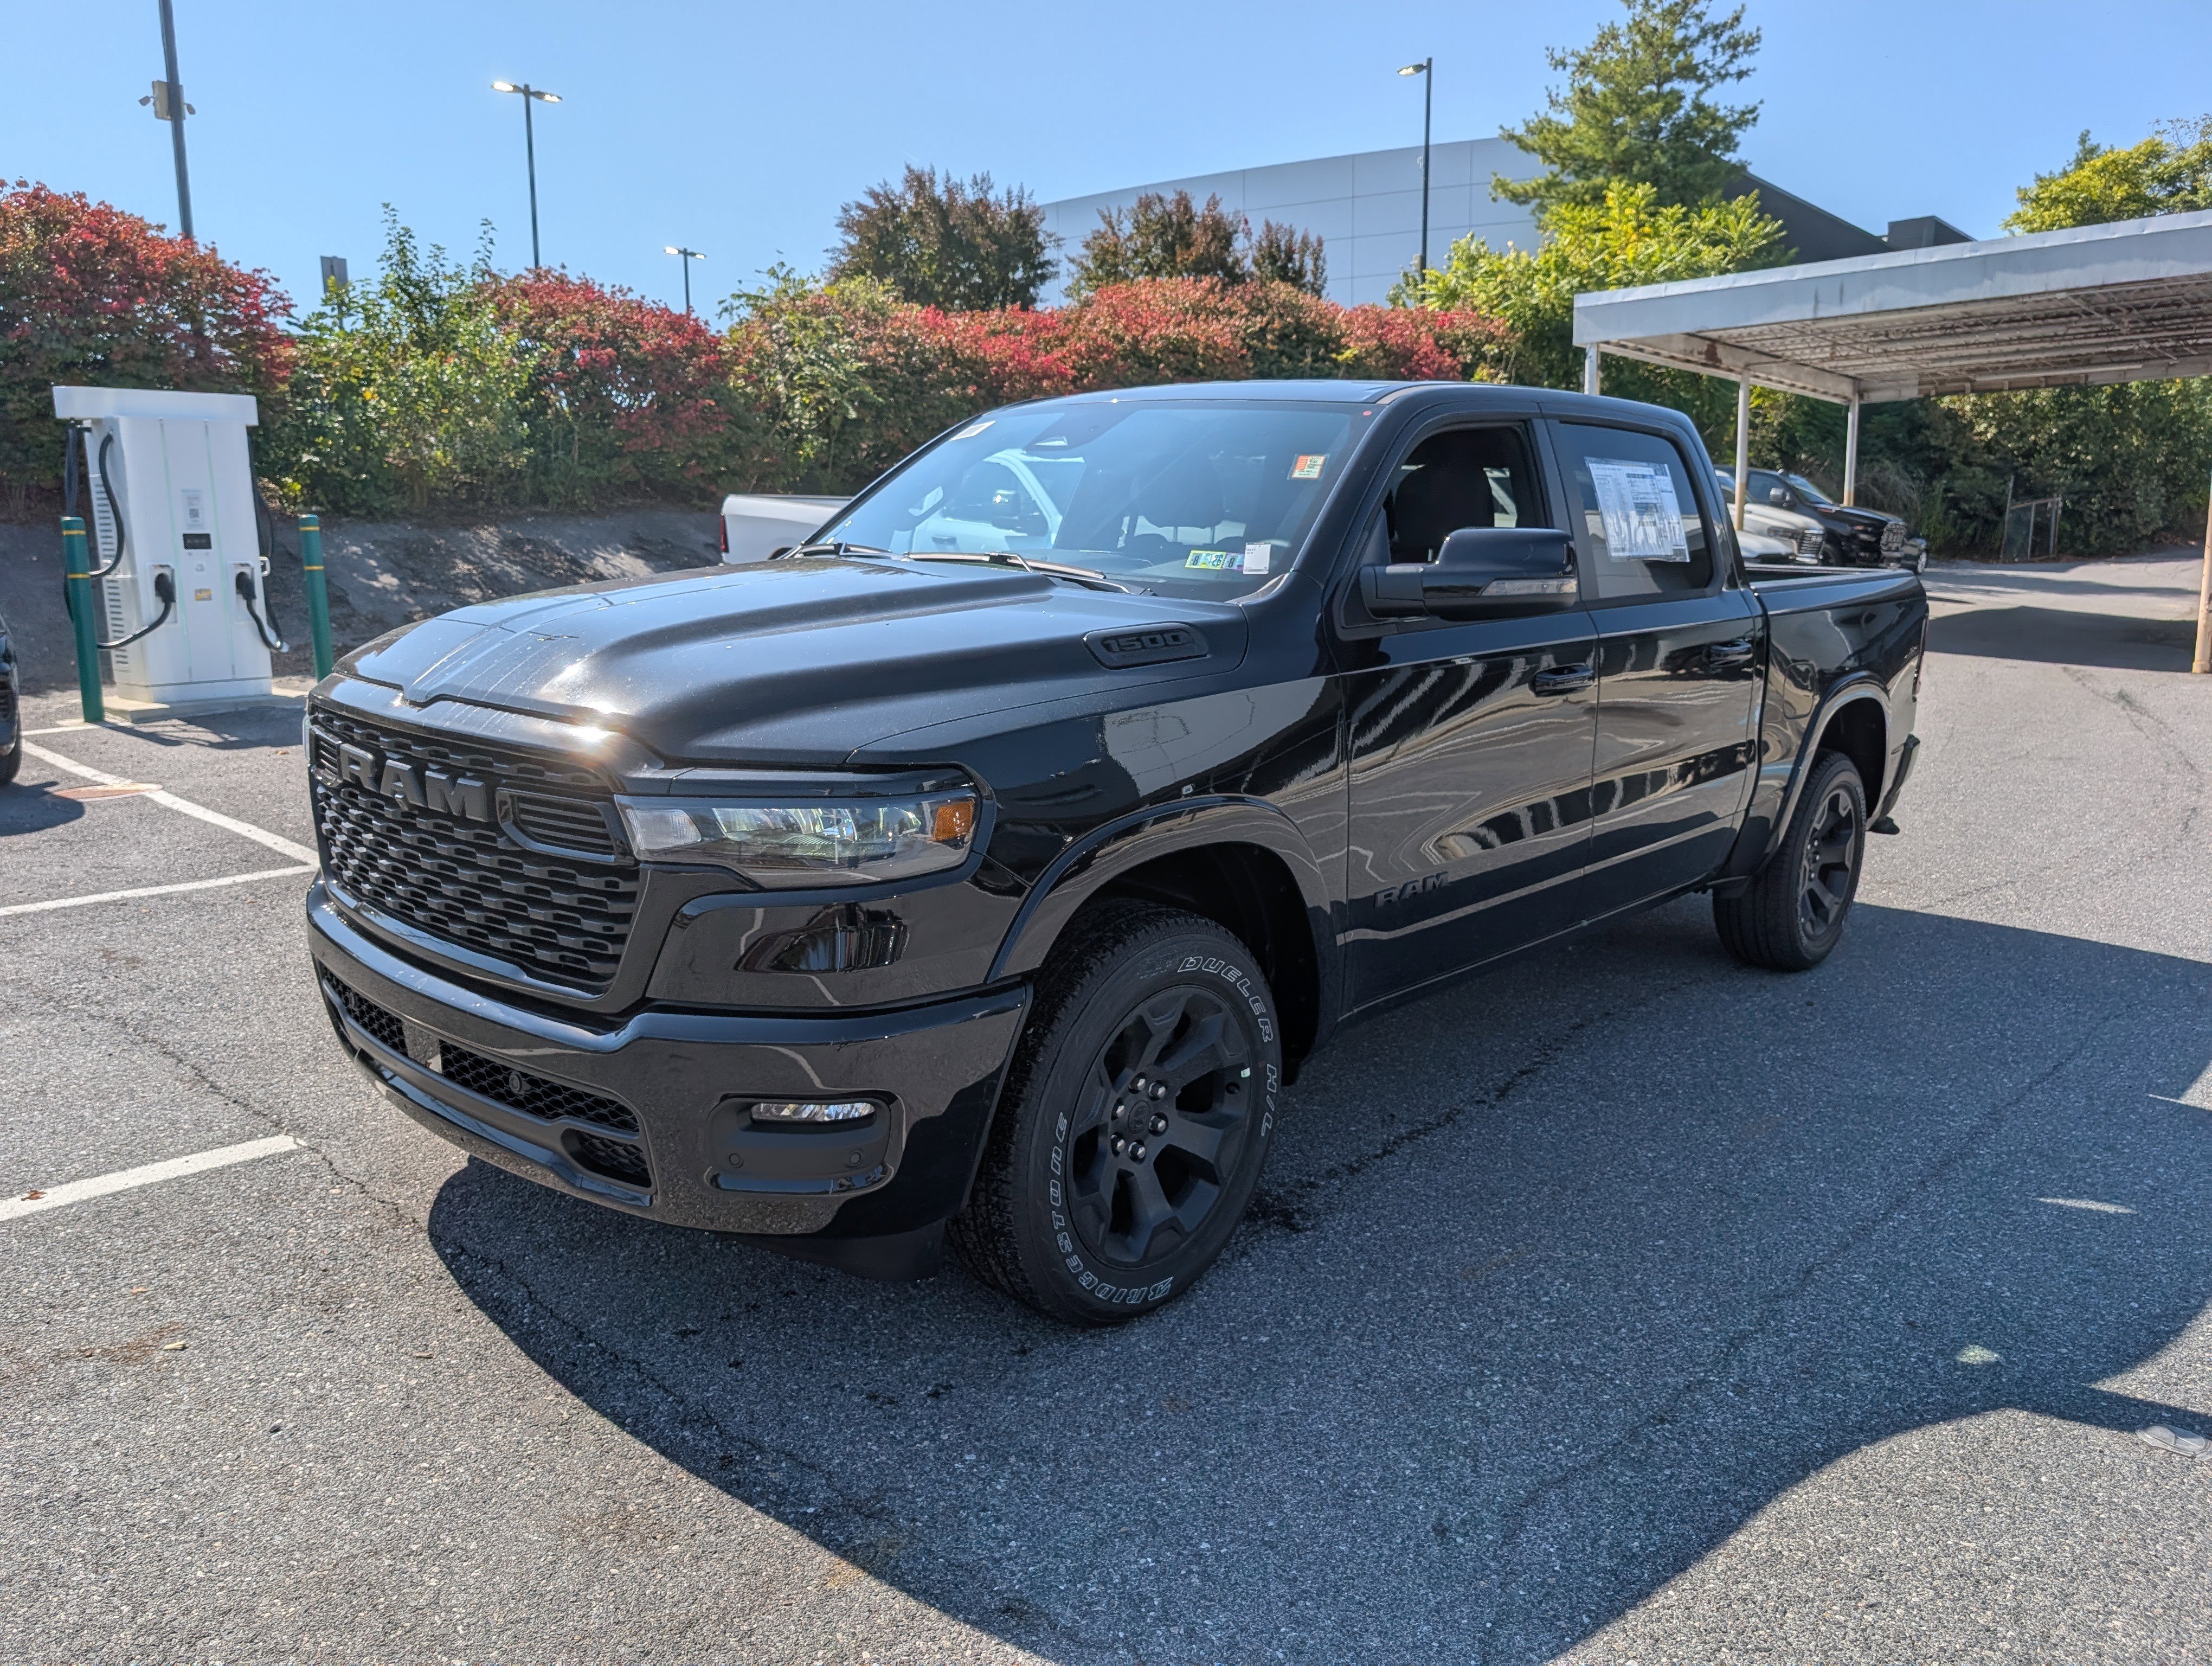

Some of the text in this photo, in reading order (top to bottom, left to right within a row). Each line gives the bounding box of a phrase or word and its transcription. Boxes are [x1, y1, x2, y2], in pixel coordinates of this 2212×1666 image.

[1192, 555, 1200, 566] 8
[1227, 558, 1236, 568] 8
[1104, 630, 1192, 652] 1500
[339, 743, 488, 823] RAM
[1372, 870, 1449, 908] RAM
[1176, 955, 1277, 1137] DUELER H/L
[1050, 1112, 1174, 1304] BRIDGESTONE
